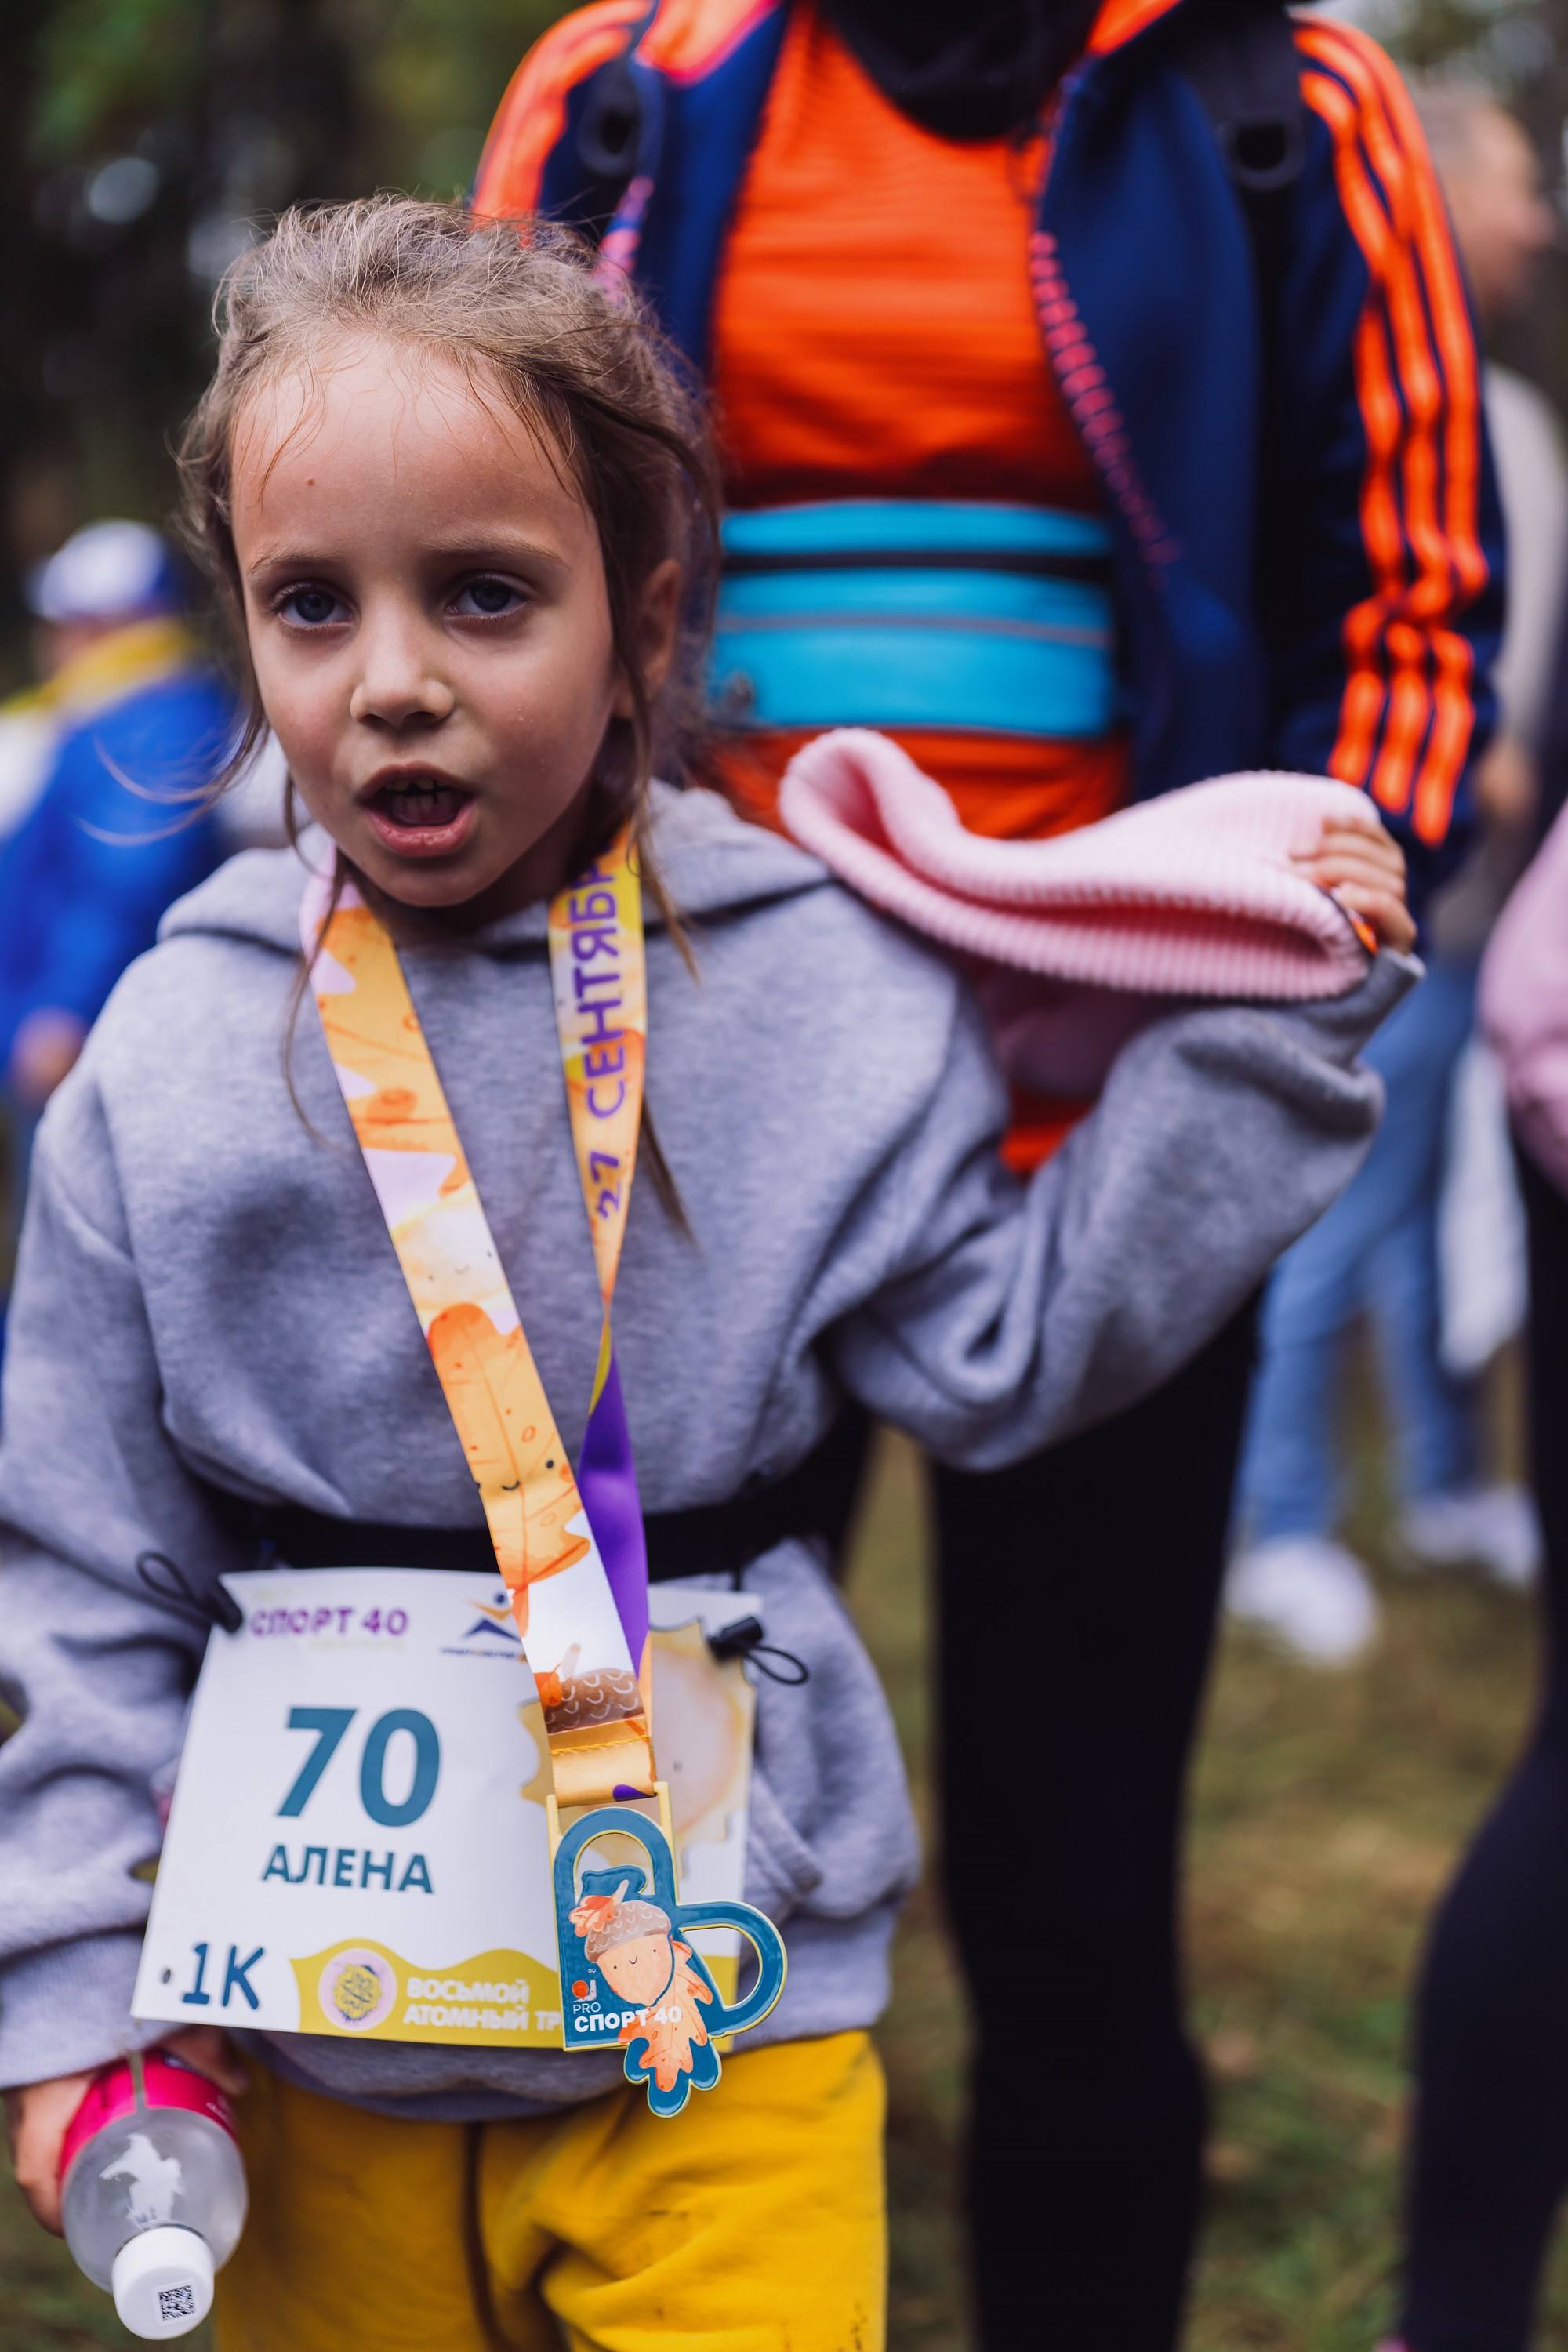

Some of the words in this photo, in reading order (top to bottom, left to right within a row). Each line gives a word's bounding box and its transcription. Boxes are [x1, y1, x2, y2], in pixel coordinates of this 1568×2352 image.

[568, 847, 626, 1120] СЕНТЯБР
[589, 1149, 622, 1220] 27
[250, 1606, 355, 1636] СПОРТ
[361, 1605, 410, 1636] 40
[274, 1707, 441, 1828] 70
[261, 1844, 434, 1894] АЛЕНА
[406, 1977, 531, 2005] ВОСЬМОЙ
[402, 2003, 530, 2031] АТОМНЫЙ
[534, 2010, 563, 2031] ТР
[572, 2001, 601, 2015] PRO
[574, 2008, 650, 2033] СПОРТ
[654, 2005, 684, 2026] 40
